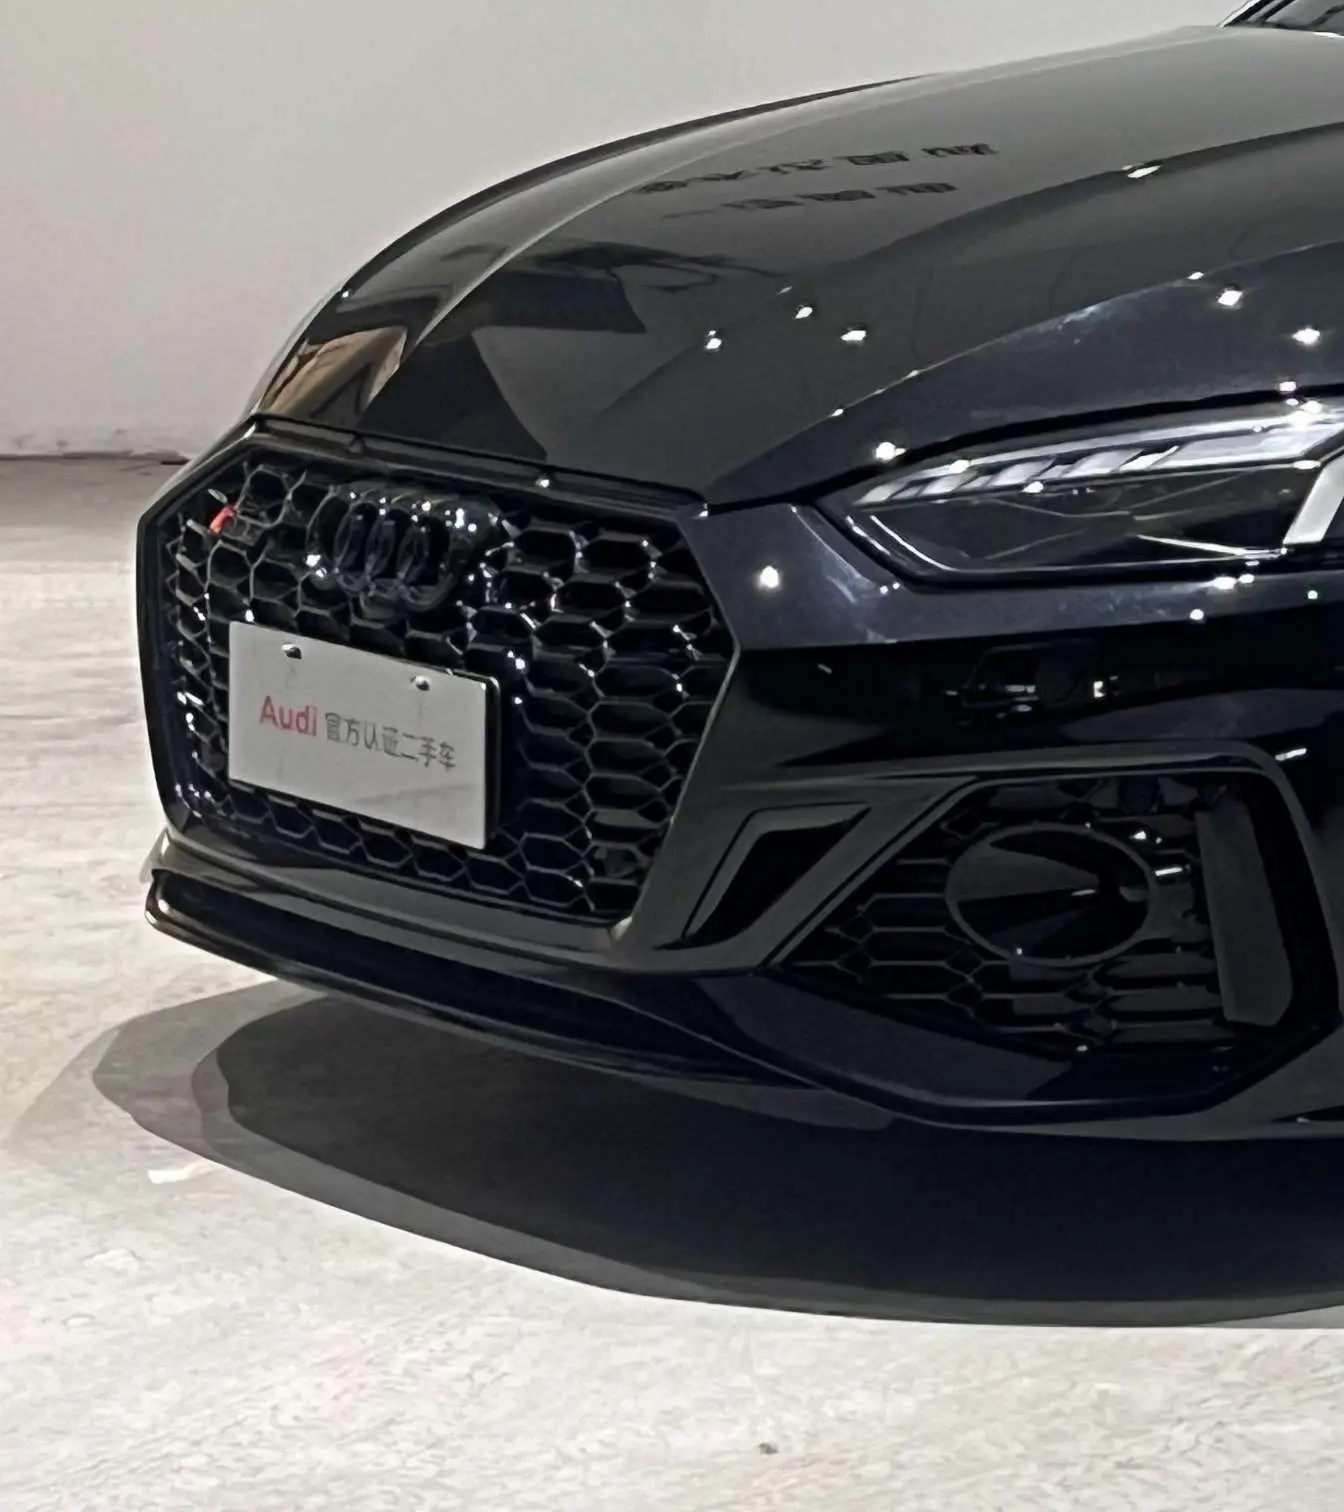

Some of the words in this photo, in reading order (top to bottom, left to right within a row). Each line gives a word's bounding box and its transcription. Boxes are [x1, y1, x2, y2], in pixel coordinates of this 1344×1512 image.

[259, 695, 317, 736] Audi
[325, 712, 456, 771] 官方认证二手车
